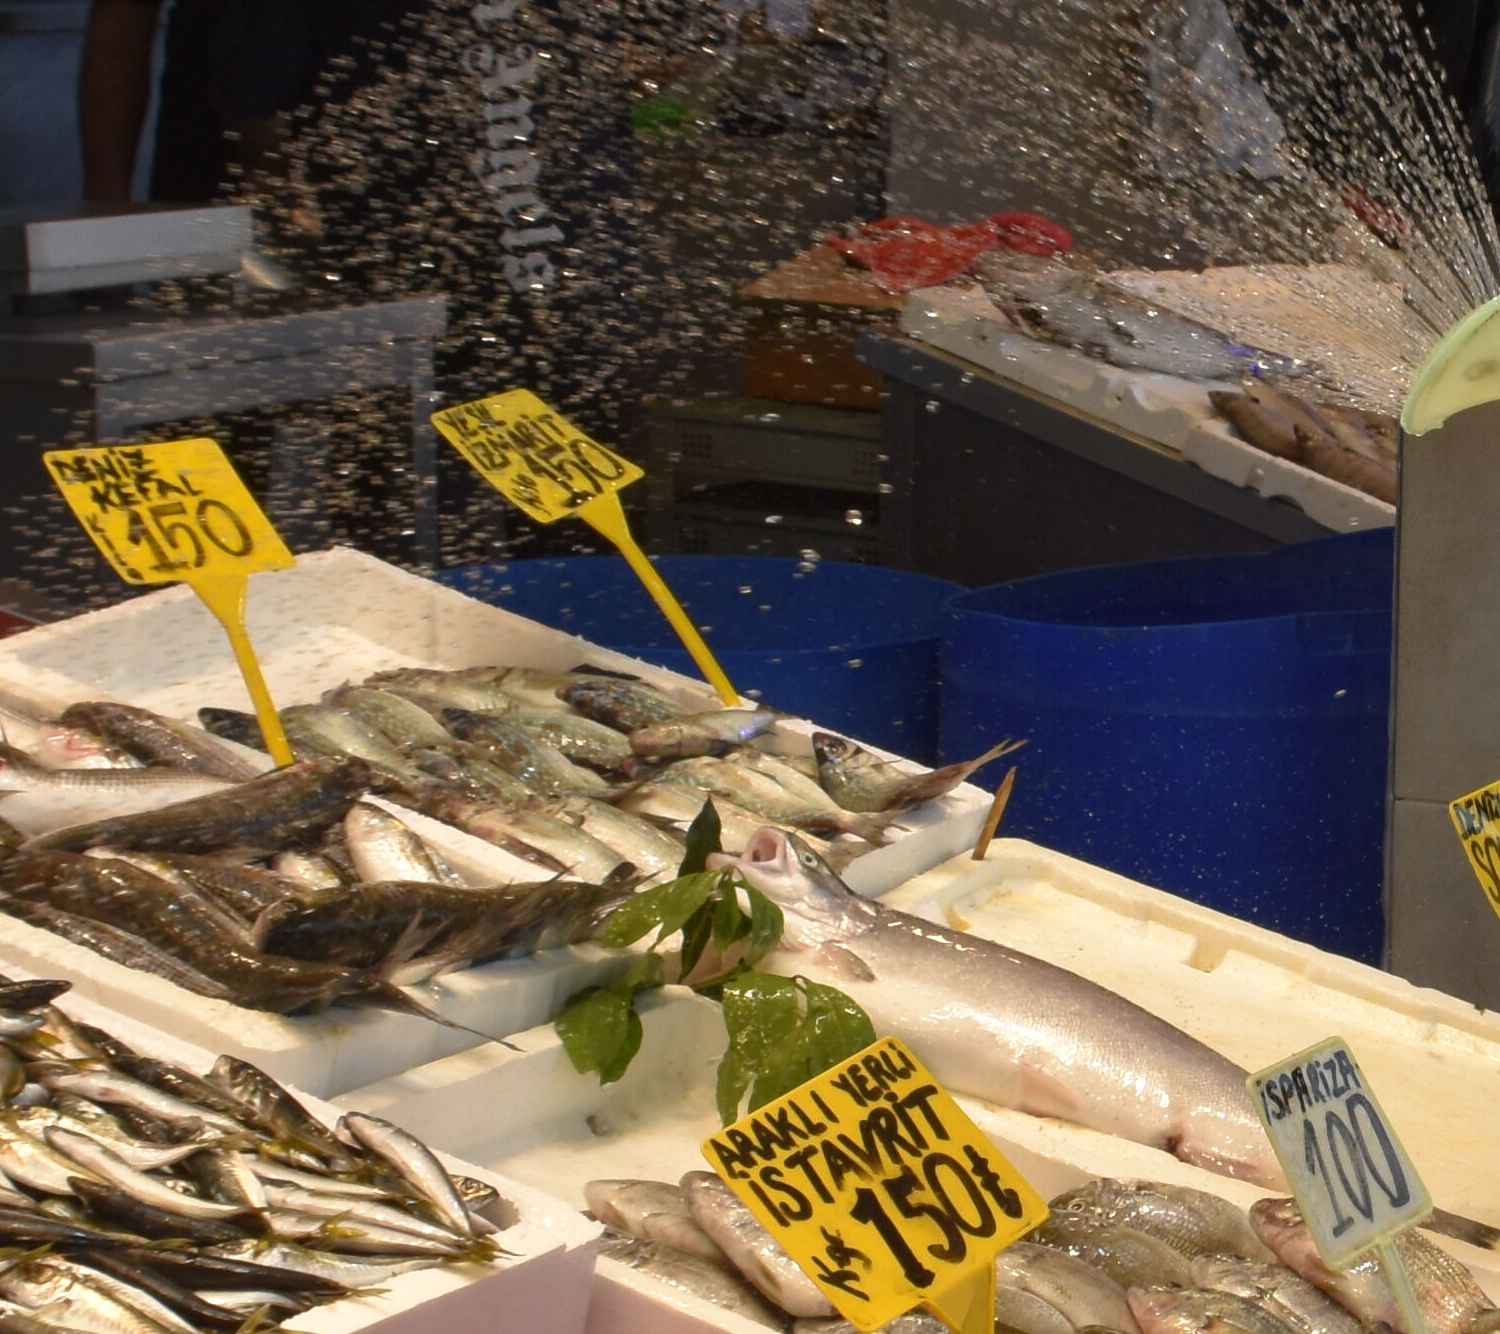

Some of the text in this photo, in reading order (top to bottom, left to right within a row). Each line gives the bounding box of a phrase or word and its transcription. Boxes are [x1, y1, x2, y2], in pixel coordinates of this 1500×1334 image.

[50, 447, 154, 485] DENİZ
[90, 469, 203, 513] KEFAL
[525, 438, 625, 509] 150
[126, 499, 254, 571] 150
[710, 1041, 918, 1180] ARAKLI YERLİ
[737, 1083, 951, 1229] İSTAVRİT
[1303, 1092, 1412, 1238] 100
